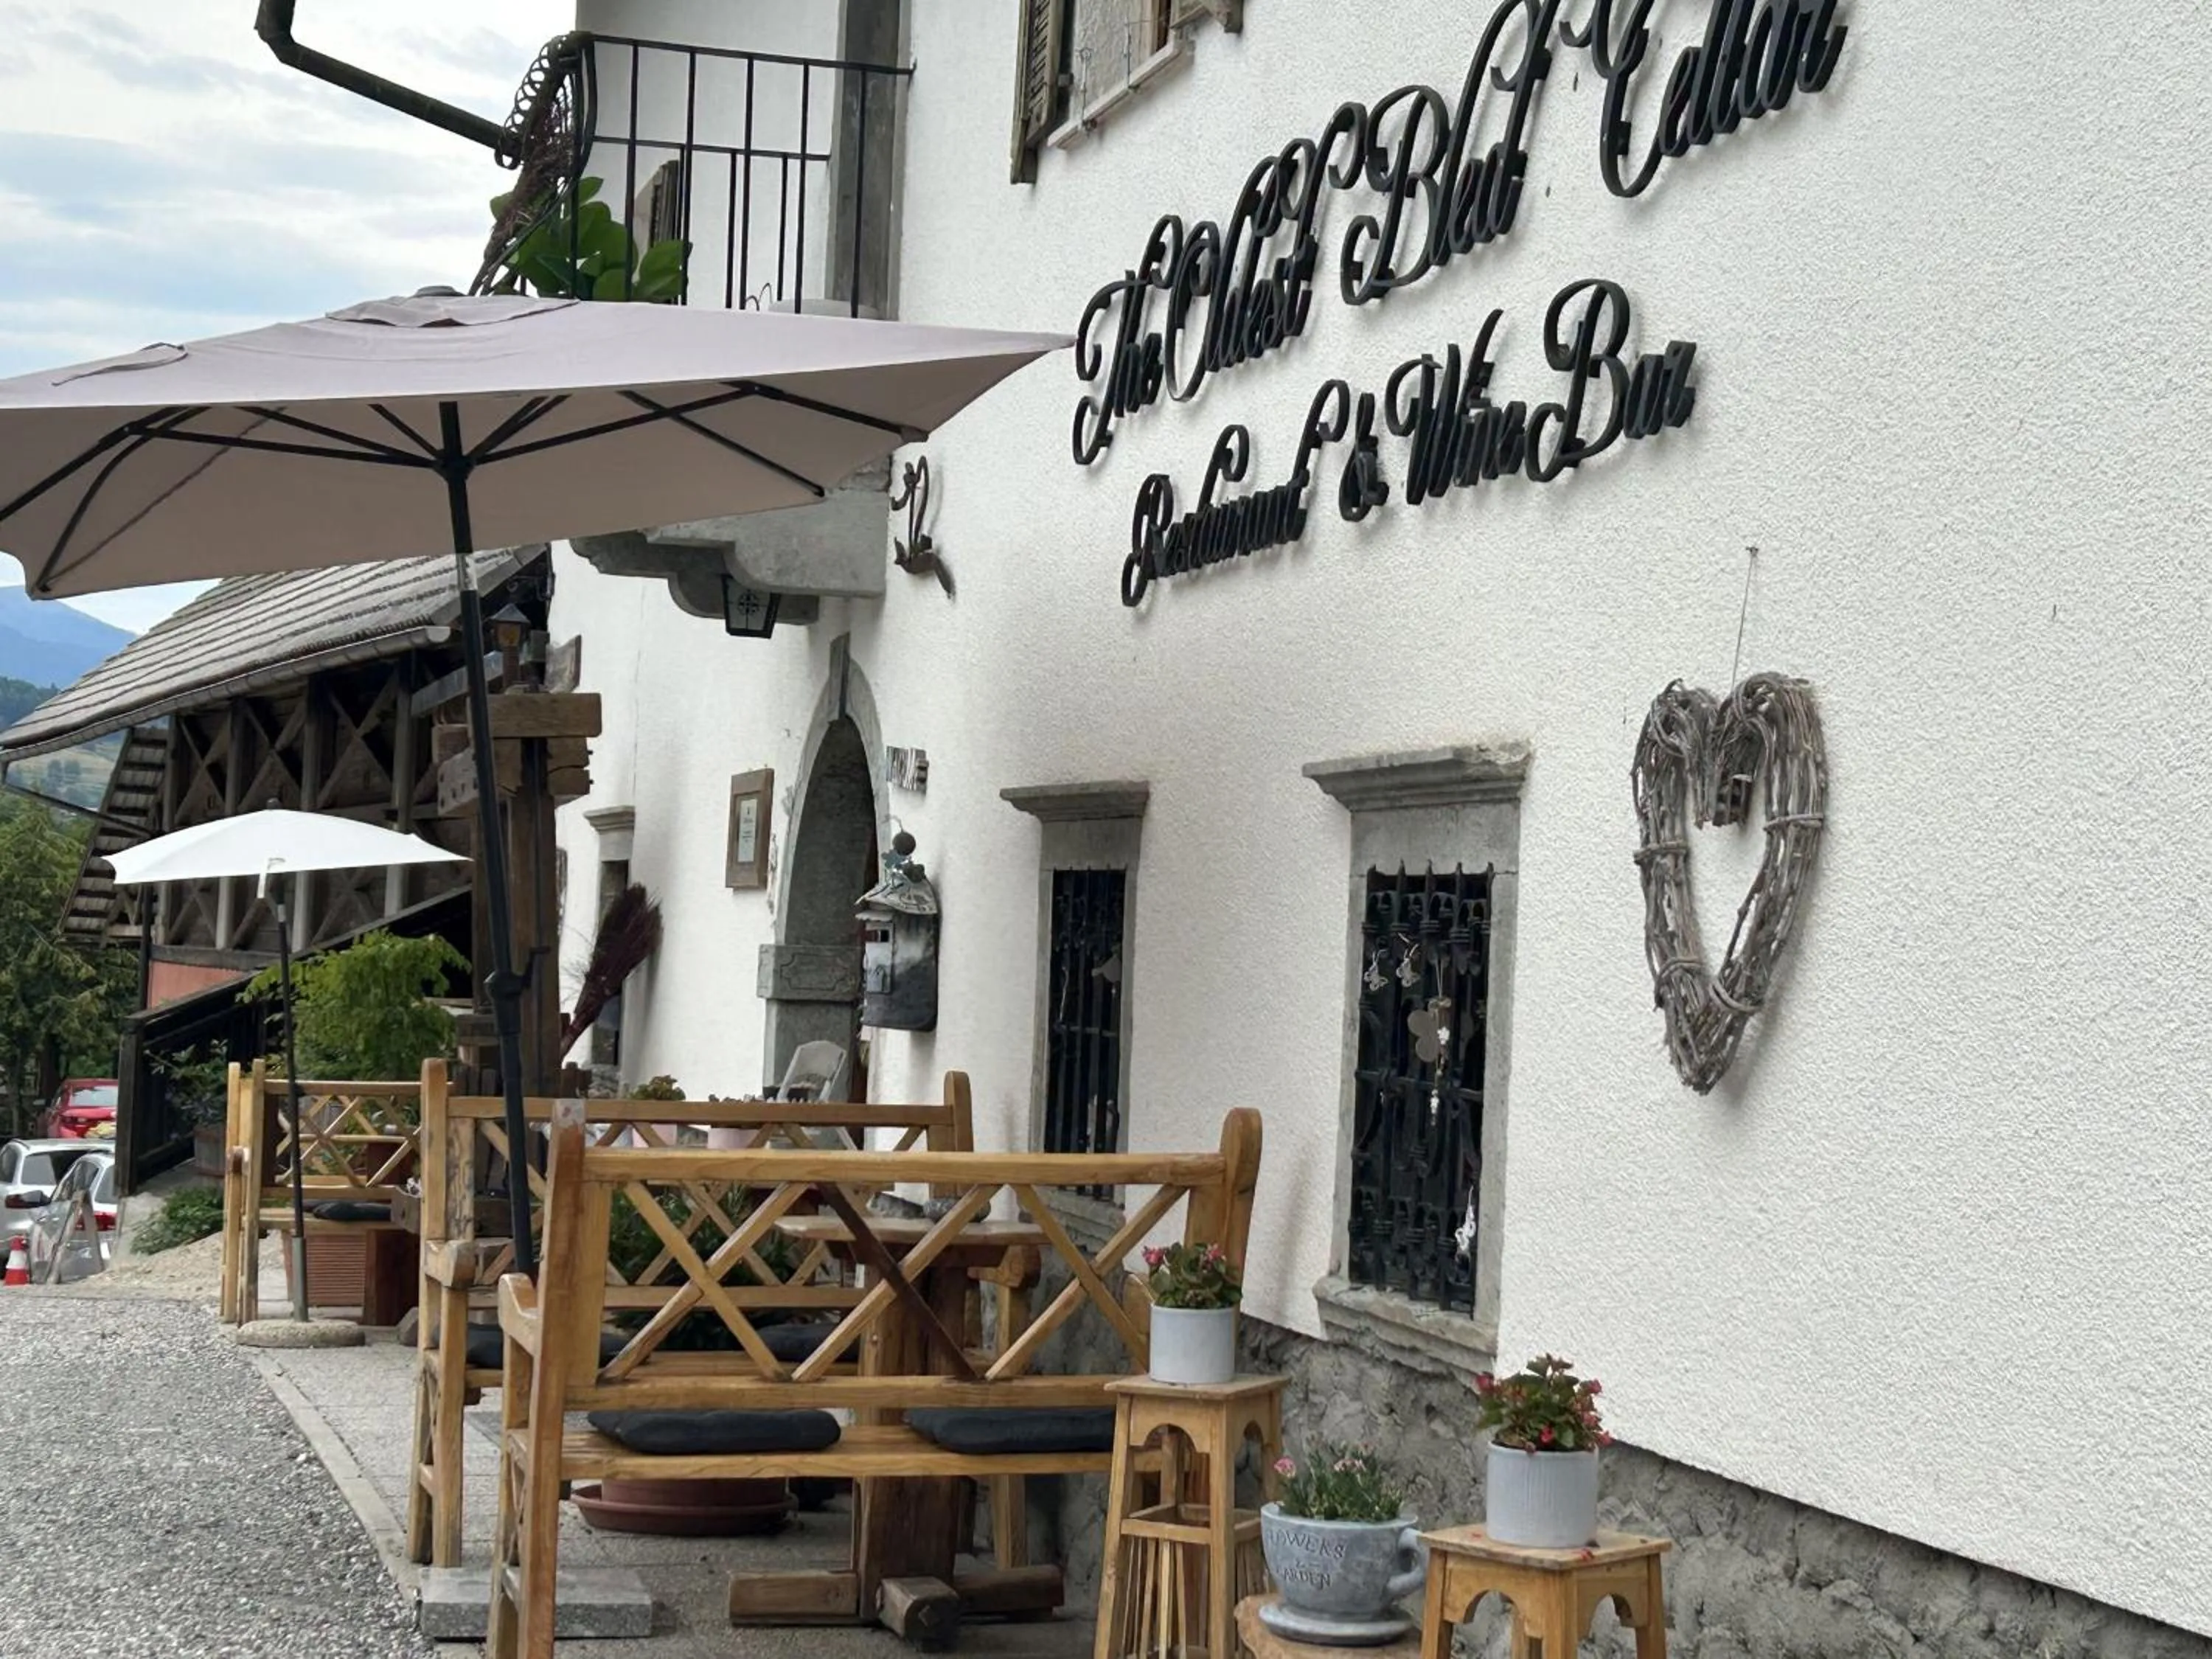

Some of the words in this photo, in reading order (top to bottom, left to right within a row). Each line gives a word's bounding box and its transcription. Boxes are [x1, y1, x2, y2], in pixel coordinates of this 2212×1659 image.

[1074, 215, 1183, 465] The
[1164, 102, 1367, 403] Oldest
[1340, 0, 1594, 305] Bled
[1591, 0, 1848, 198] Cellar
[1121, 380, 1350, 607] Restaurant
[1338, 392, 1389, 522] &
[1385, 309, 1526, 505] Wine
[1525, 278, 1697, 482] Bar
